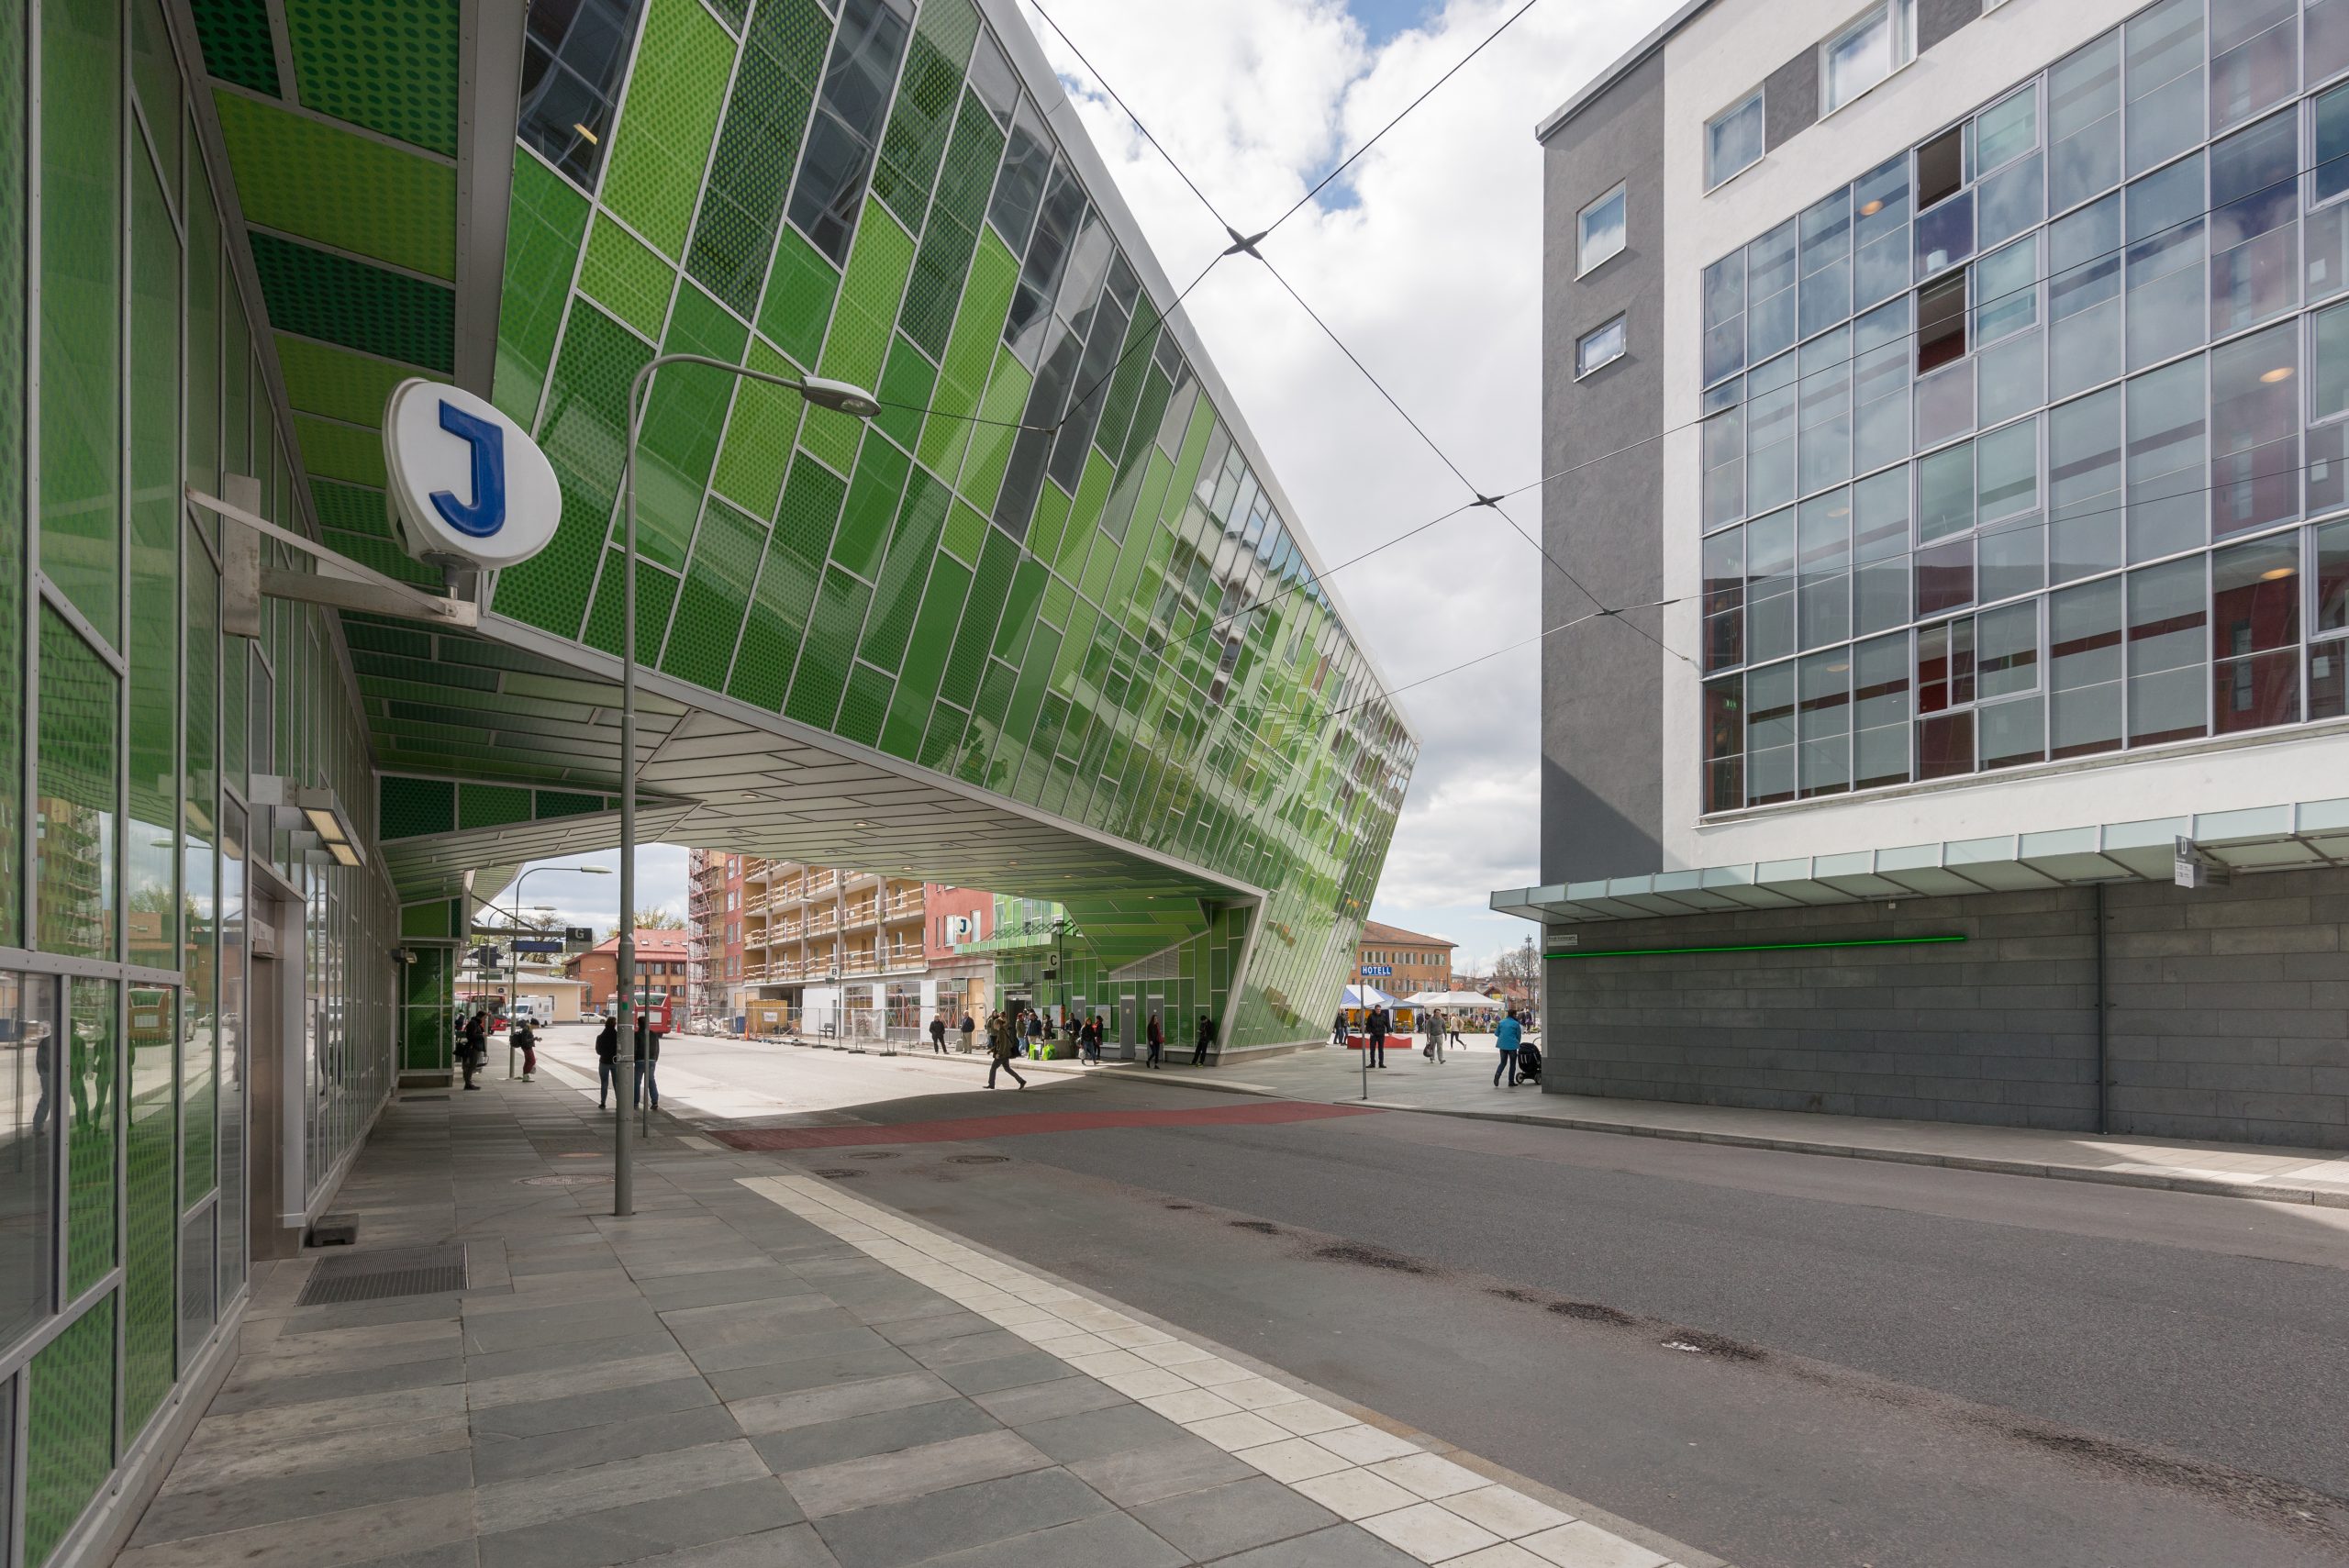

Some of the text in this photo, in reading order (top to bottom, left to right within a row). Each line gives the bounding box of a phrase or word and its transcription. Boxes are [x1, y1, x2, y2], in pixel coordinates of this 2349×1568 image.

[429, 398, 506, 539] J
[2181, 837, 2188, 855] D
[960, 918, 967, 933] J
[574, 929, 584, 940] G
[1050, 954, 1058, 966] C
[1362, 966, 1391, 975] HOTELL
